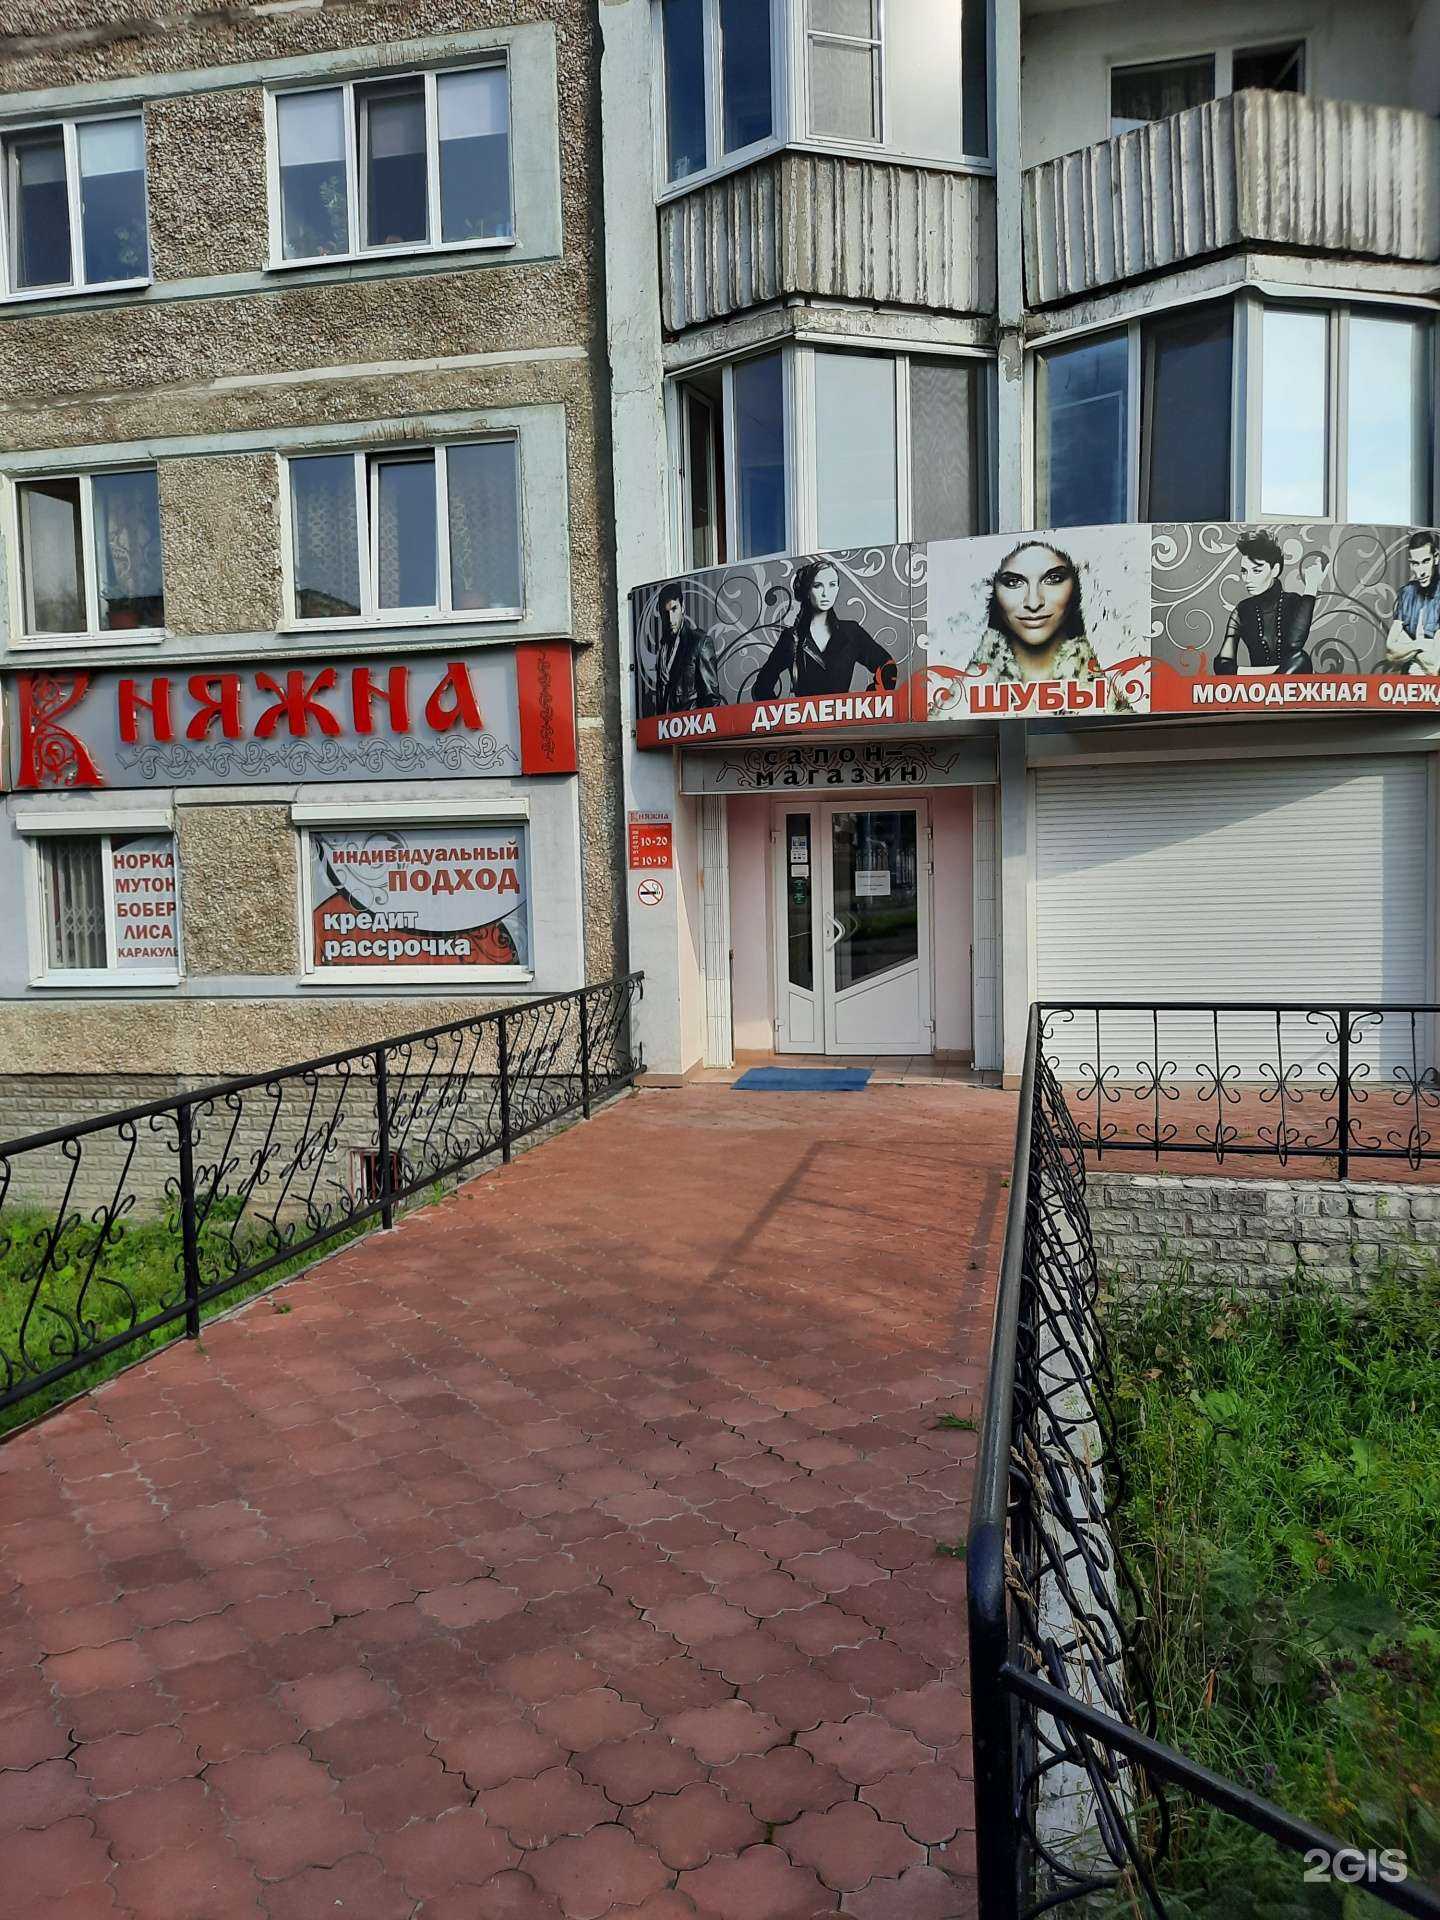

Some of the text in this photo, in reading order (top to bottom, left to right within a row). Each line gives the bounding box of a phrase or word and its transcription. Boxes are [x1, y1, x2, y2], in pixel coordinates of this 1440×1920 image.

[969, 679, 1106, 714] ШУБЫ
[1192, 682, 1440, 706] МОЛОДЕЖНАЯ ОДЕЖ
[657, 695, 894, 740] КОЖА ДУБЛЕНКИ
[113, 853, 175, 869] НОРКА
[332, 840, 520, 866] индивидуальный
[115, 877, 176, 894] МУТОН
[117, 901, 177, 918] БОБЕР
[124, 924, 173, 940] ЛИСА
[323, 911, 419, 935] кредит
[324, 938, 472, 961] рассрочка
